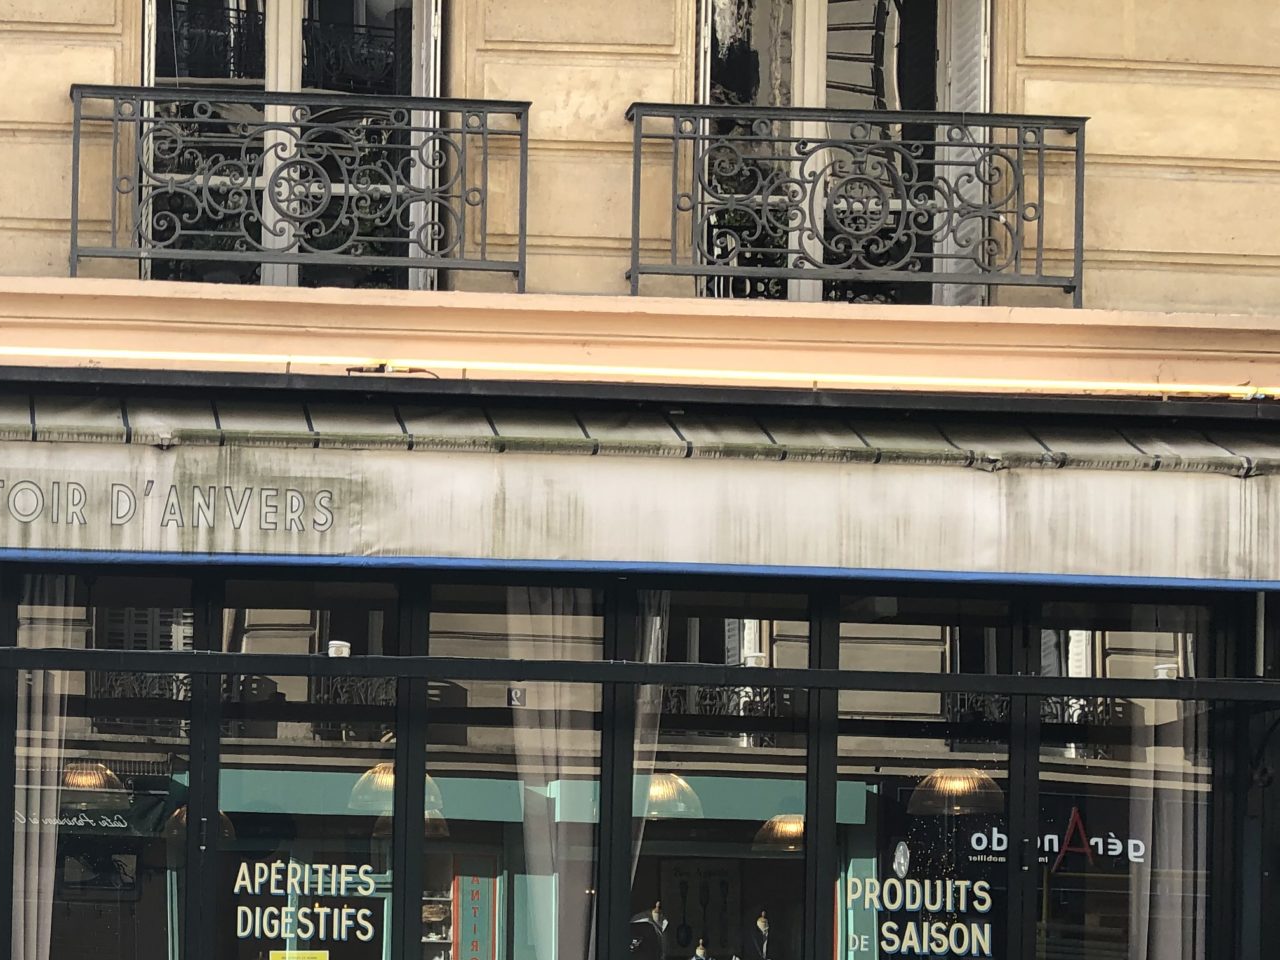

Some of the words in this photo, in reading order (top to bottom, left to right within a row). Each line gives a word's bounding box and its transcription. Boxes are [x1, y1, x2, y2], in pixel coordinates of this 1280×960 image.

[111, 480, 334, 533] D'ANVERS
[234, 860, 376, 896] APÉRITIFS
[847, 878, 993, 913] PRODUITS
[237, 906, 375, 942] DIGESTIFS
[848, 934, 870, 951] DE
[880, 921, 992, 957] SAISON
